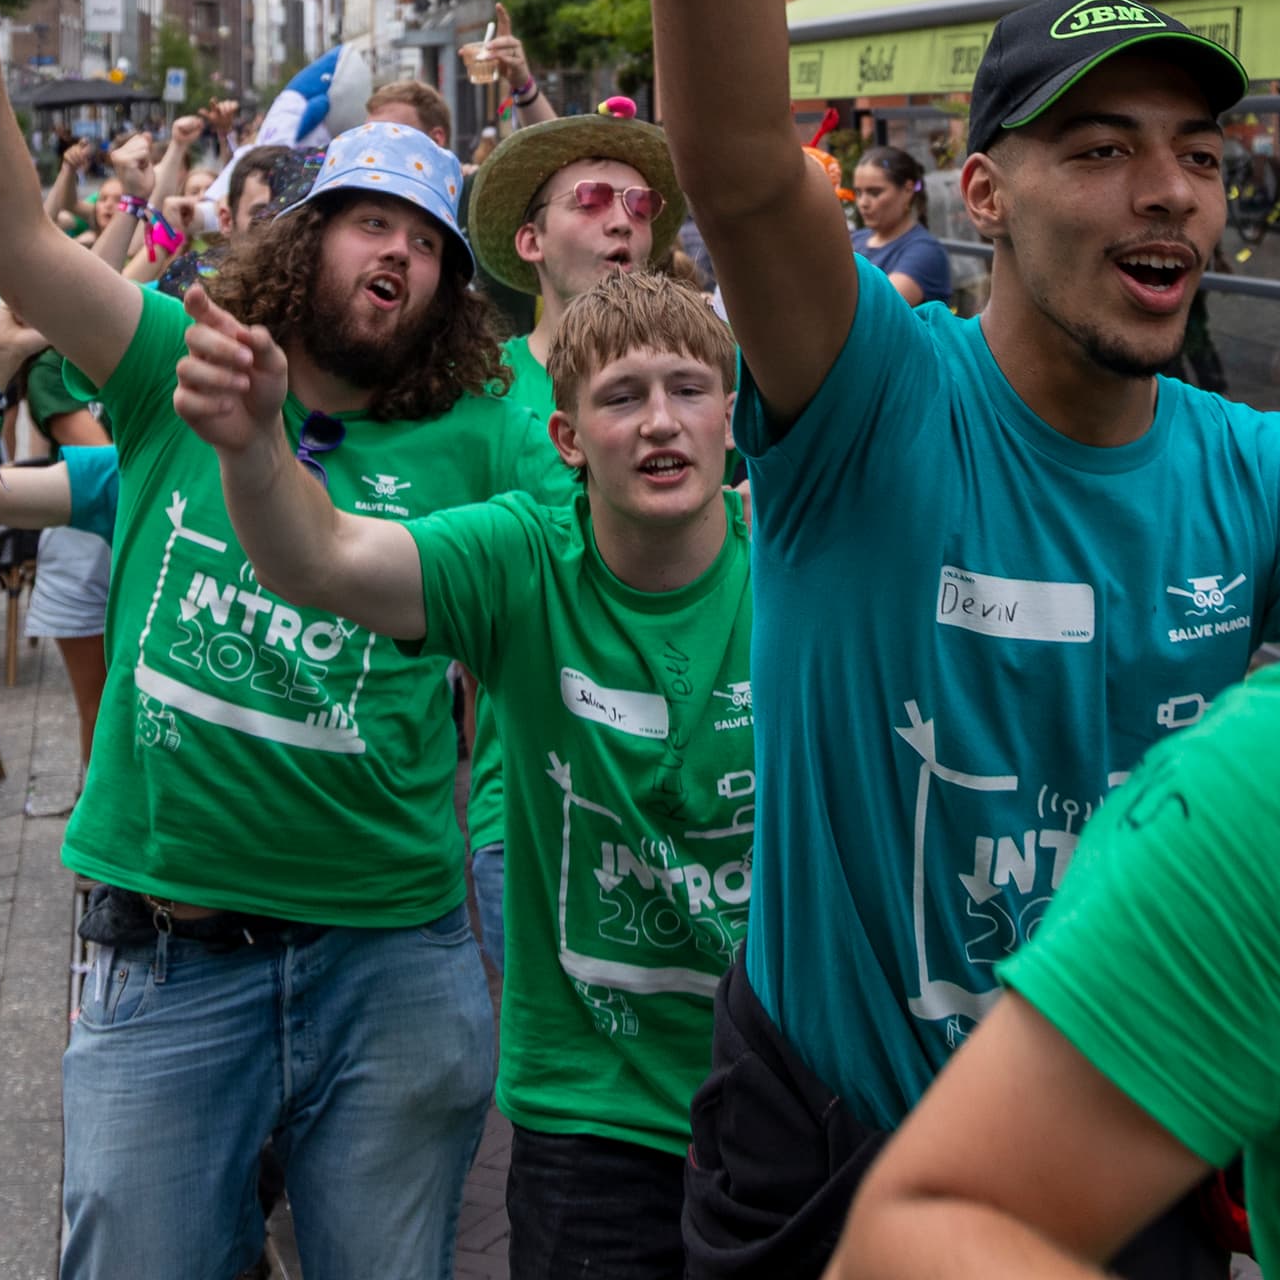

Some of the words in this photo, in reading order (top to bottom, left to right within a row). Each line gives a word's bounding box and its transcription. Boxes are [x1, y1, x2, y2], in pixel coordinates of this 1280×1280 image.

[1070, 5, 1150, 32] JBM
[179, 571, 344, 662] INTRO
[1168, 623, 1213, 643] SALVE
[1215, 615, 1251, 635] MUNDI
[169, 615, 329, 707] 2025
[714, 716, 751, 732] SALVE
[593, 841, 754, 915] INTRO
[958, 829, 1081, 905] INT
